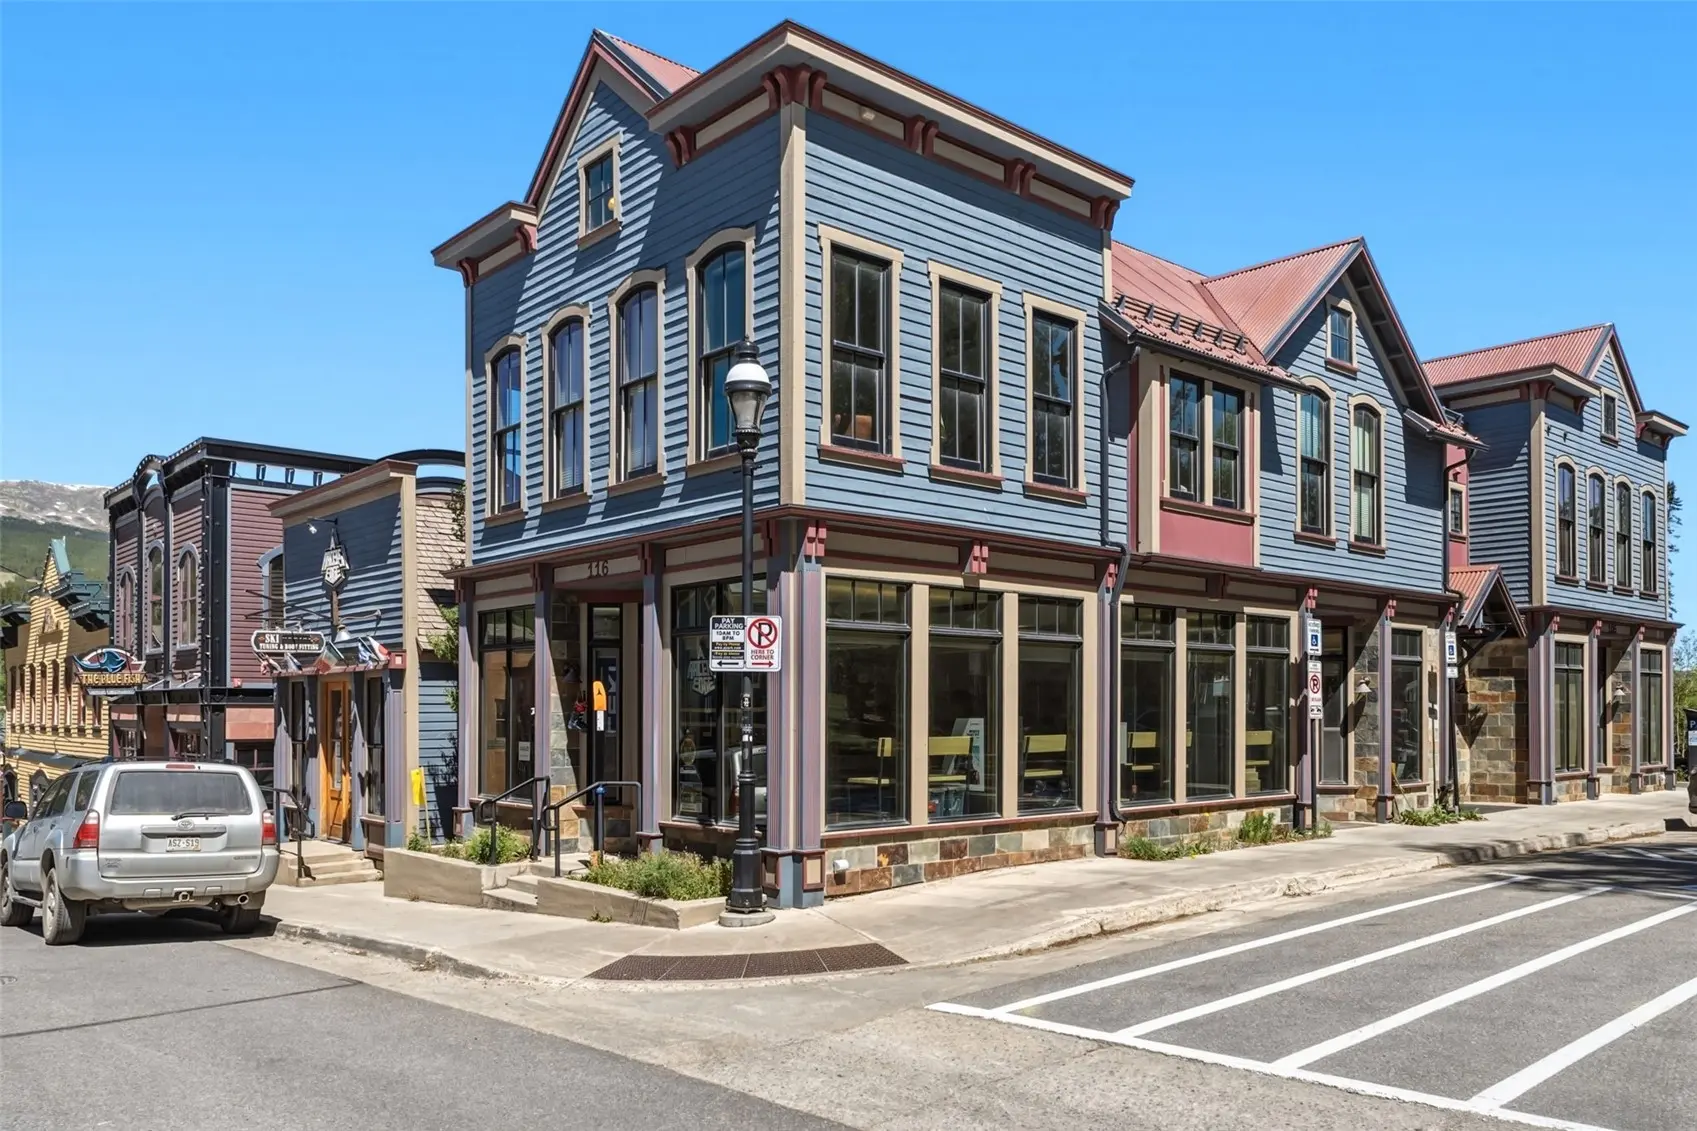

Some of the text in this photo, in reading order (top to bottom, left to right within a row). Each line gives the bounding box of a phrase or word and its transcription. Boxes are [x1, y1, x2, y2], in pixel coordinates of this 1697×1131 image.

[588, 560, 609, 577] 116
[265, 634, 279, 643] SKI
[83, 673, 141, 684] THE BLUE FISH
